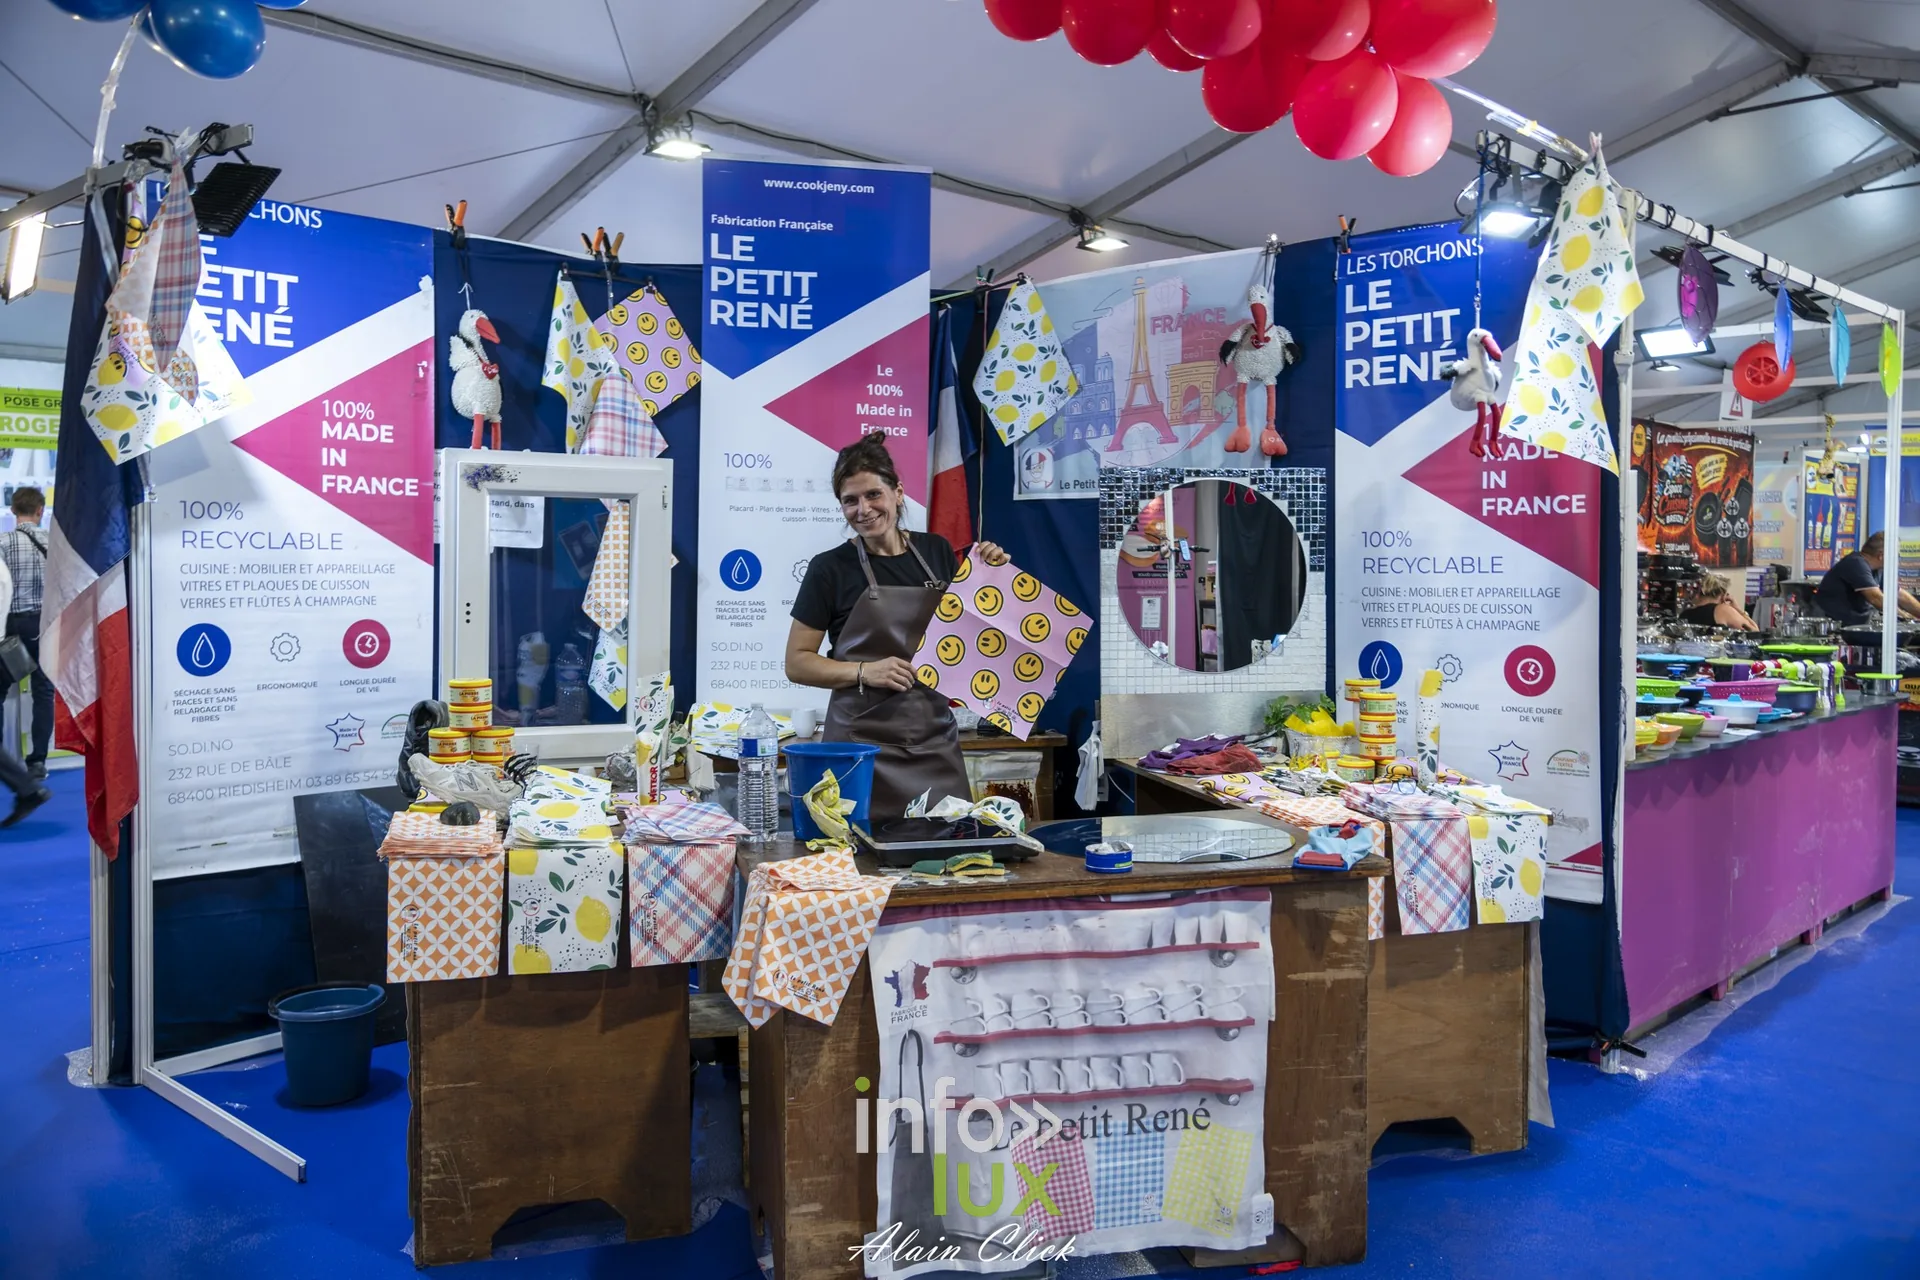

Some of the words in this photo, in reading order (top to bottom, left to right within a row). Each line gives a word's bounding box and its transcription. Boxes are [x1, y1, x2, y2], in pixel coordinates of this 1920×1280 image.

[764, 178, 874, 194] www.cookjeny.com
[248, 200, 322, 228] CHONS
[711, 214, 776, 228] Fabrication
[779, 218, 833, 232] Française
[710, 232, 755, 262] LE
[1347, 255, 1376, 275] LES
[1380, 237, 1484, 270] TORCHONS
[196, 263, 299, 306] ETIT
[711, 266, 818, 297] PETIT
[1346, 280, 1392, 314] LE
[710, 297, 813, 330] RENÉ
[1151, 306, 1226, 335] FRANCE
[200, 305, 294, 348] ENÉ
[1346, 308, 1460, 351] PETIT
[877, 365, 893, 376] Le
[1346, 340, 1457, 389] RENÉ
[867, 384, 903, 396] 100%
[4, 396, 40, 407] POSE
[322, 400, 375, 421] 100%
[856, 403, 895, 416] Made
[899, 405, 912, 417] in
[322, 421, 394, 443] MADE
[322, 448, 347, 467] IN
[724, 452, 772, 469] 100%
[322, 474, 419, 496] FRANCE
[1060, 478, 1072, 490] Le
[1075, 477, 1096, 490] Petit
[1482, 470, 1506, 489] IN
[180, 500, 244, 520] 100%
[1482, 494, 1586, 516] FRANCE
[182, 530, 343, 550] RECYCLABLE
[1362, 530, 1412, 548] 100%
[180, 564, 230, 575] CUISINE
[240, 564, 296, 574] MOBILIER
[300, 564, 314, 574] ET
[316, 564, 396, 574] APPAREILLAGE
[1363, 556, 1503, 574] RECYCLABLE
[180, 580, 222, 592] VITRES
[226, 580, 240, 592] ET
[243, 580, 299, 593] PLAQUES
[302, 580, 318, 591] DE
[321, 580, 370, 591] CUISSON
[1362, 587, 1402, 598] CUISINE
[1409, 587, 1459, 598] MOBILIER
[1462, 587, 1474, 598] ET
[1476, 587, 1561, 598] APPAREILLAGE
[180, 598, 226, 609] VERRES
[230, 598, 244, 609] ET
[248, 594, 291, 608] FLÛTES
[294, 594, 302, 607] À
[305, 596, 377, 607] CHAMPAGNE
[1362, 602, 1395, 613] VITRES
[1398, 603, 1410, 613] ET
[1412, 603, 1460, 615] PLAQUES
[1463, 604, 1478, 614] DE
[1481, 604, 1532, 615] CUISSON
[1362, 618, 1398, 628] VERRES
[1401, 618, 1413, 629] ET
[1416, 616, 1453, 629] FLÛTES
[1456, 616, 1464, 629] À
[1466, 620, 1540, 631] CHAMPAGNE
[711, 642, 763, 652] SO.DI.NO
[711, 661, 730, 670] 232
[734, 661, 757, 670] RUE
[761, 661, 777, 670] DE
[256, 681, 318, 691] ERGONOMIQUE
[340, 678, 370, 687] LONGUE
[372, 676, 397, 685] DURÉE
[711, 680, 747, 689] 68400
[750, 680, 812, 689] RIEDISH
[172, 698, 202, 706] TRACES
[174, 688, 211, 698] SÉCHAGE
[174, 706, 222, 716] RELARGAGE
[1441, 702, 1479, 710] NOMIQUE
[1502, 706, 1533, 715] LONGUE
[1536, 706, 1562, 715] DURÉE
[192, 714, 220, 723] FIBRES
[168, 739, 233, 757] SO.DI.NO
[168, 768, 192, 782] 232
[197, 763, 226, 777] RUE
[231, 761, 250, 774] DE
[255, 755, 292, 771] BÂLE
[168, 788, 214, 805] 68400
[218, 778, 301, 799] RIEDISHEIM
[306, 776, 322, 788] 03
[325, 774, 341, 786] 89
[345, 772, 360, 784] 65
[363, 771, 379, 783] 54
[382, 769, 398, 781] 54
[891, 1010, 927, 1024] FRANCE
[1124, 1098, 1210, 1135] René
